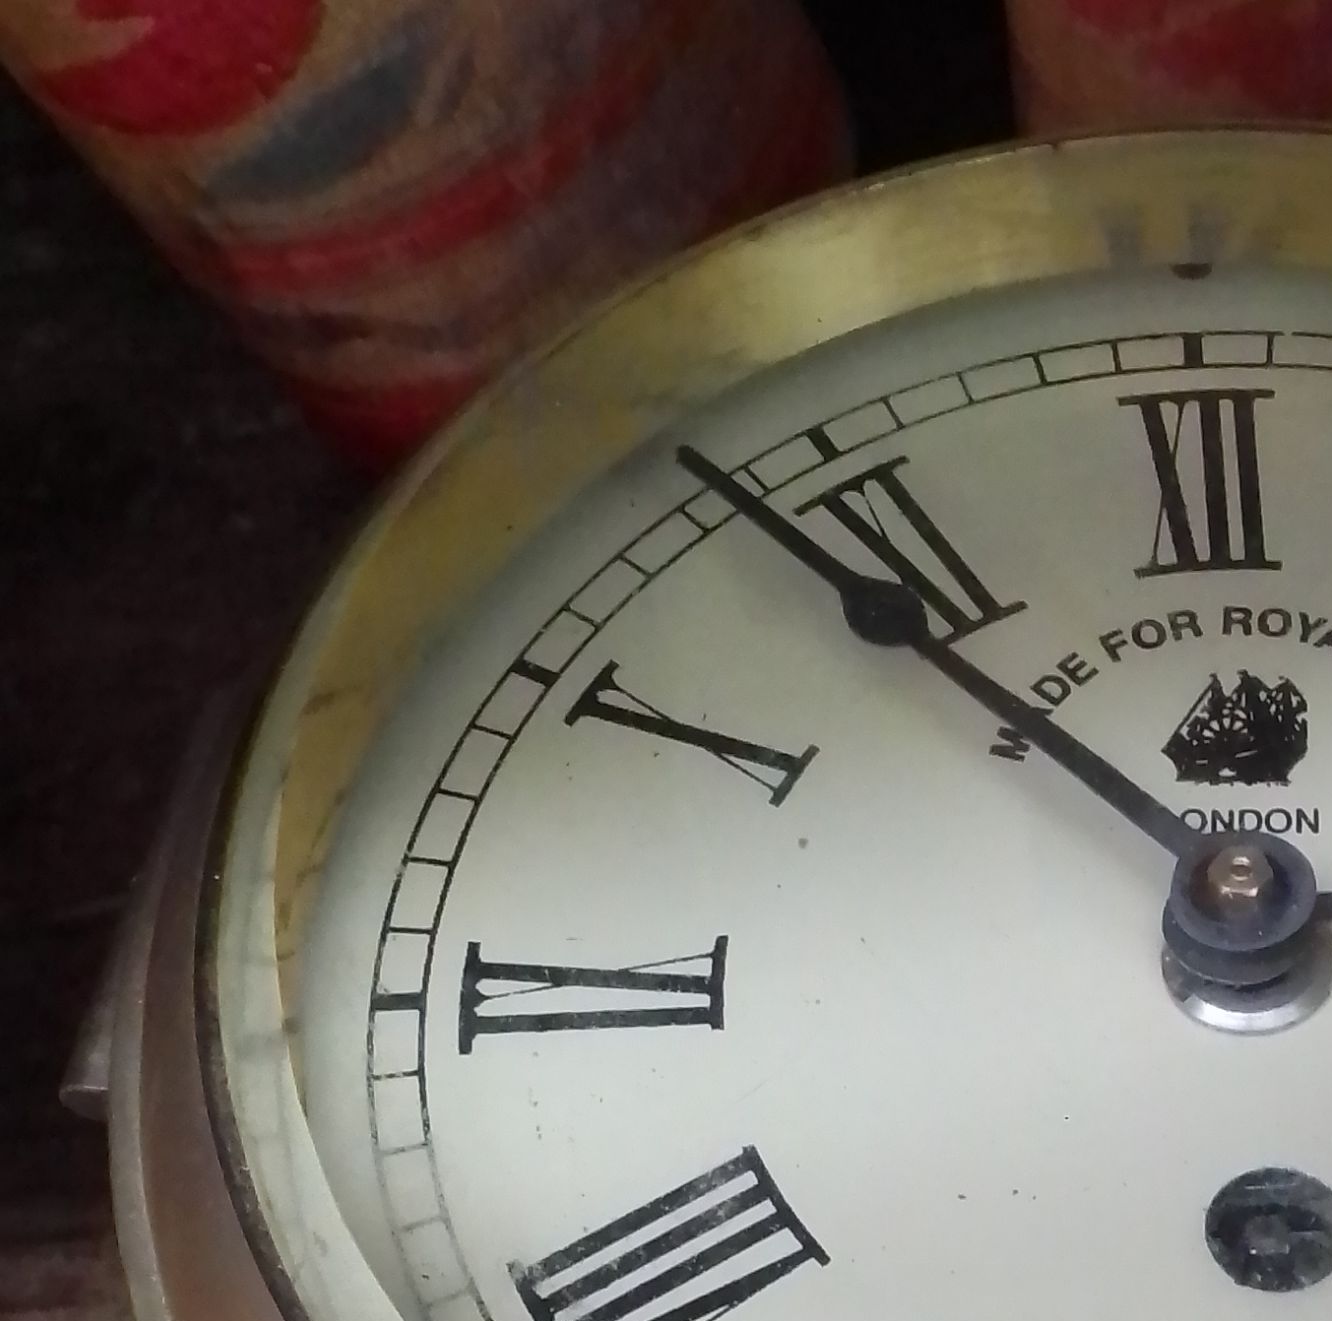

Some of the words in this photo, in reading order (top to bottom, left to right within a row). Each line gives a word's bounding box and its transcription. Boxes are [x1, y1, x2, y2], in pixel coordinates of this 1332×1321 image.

[793, 455, 1027, 646] XI
[1117, 389, 1282, 579] XII
[564, 660, 820, 807] X
[989, 652, 1099, 762] MDE
[1098, 609, 1203, 663] FOR
[1181, 808, 1320, 835] ONDON
[459, 935, 728, 1054] IX
